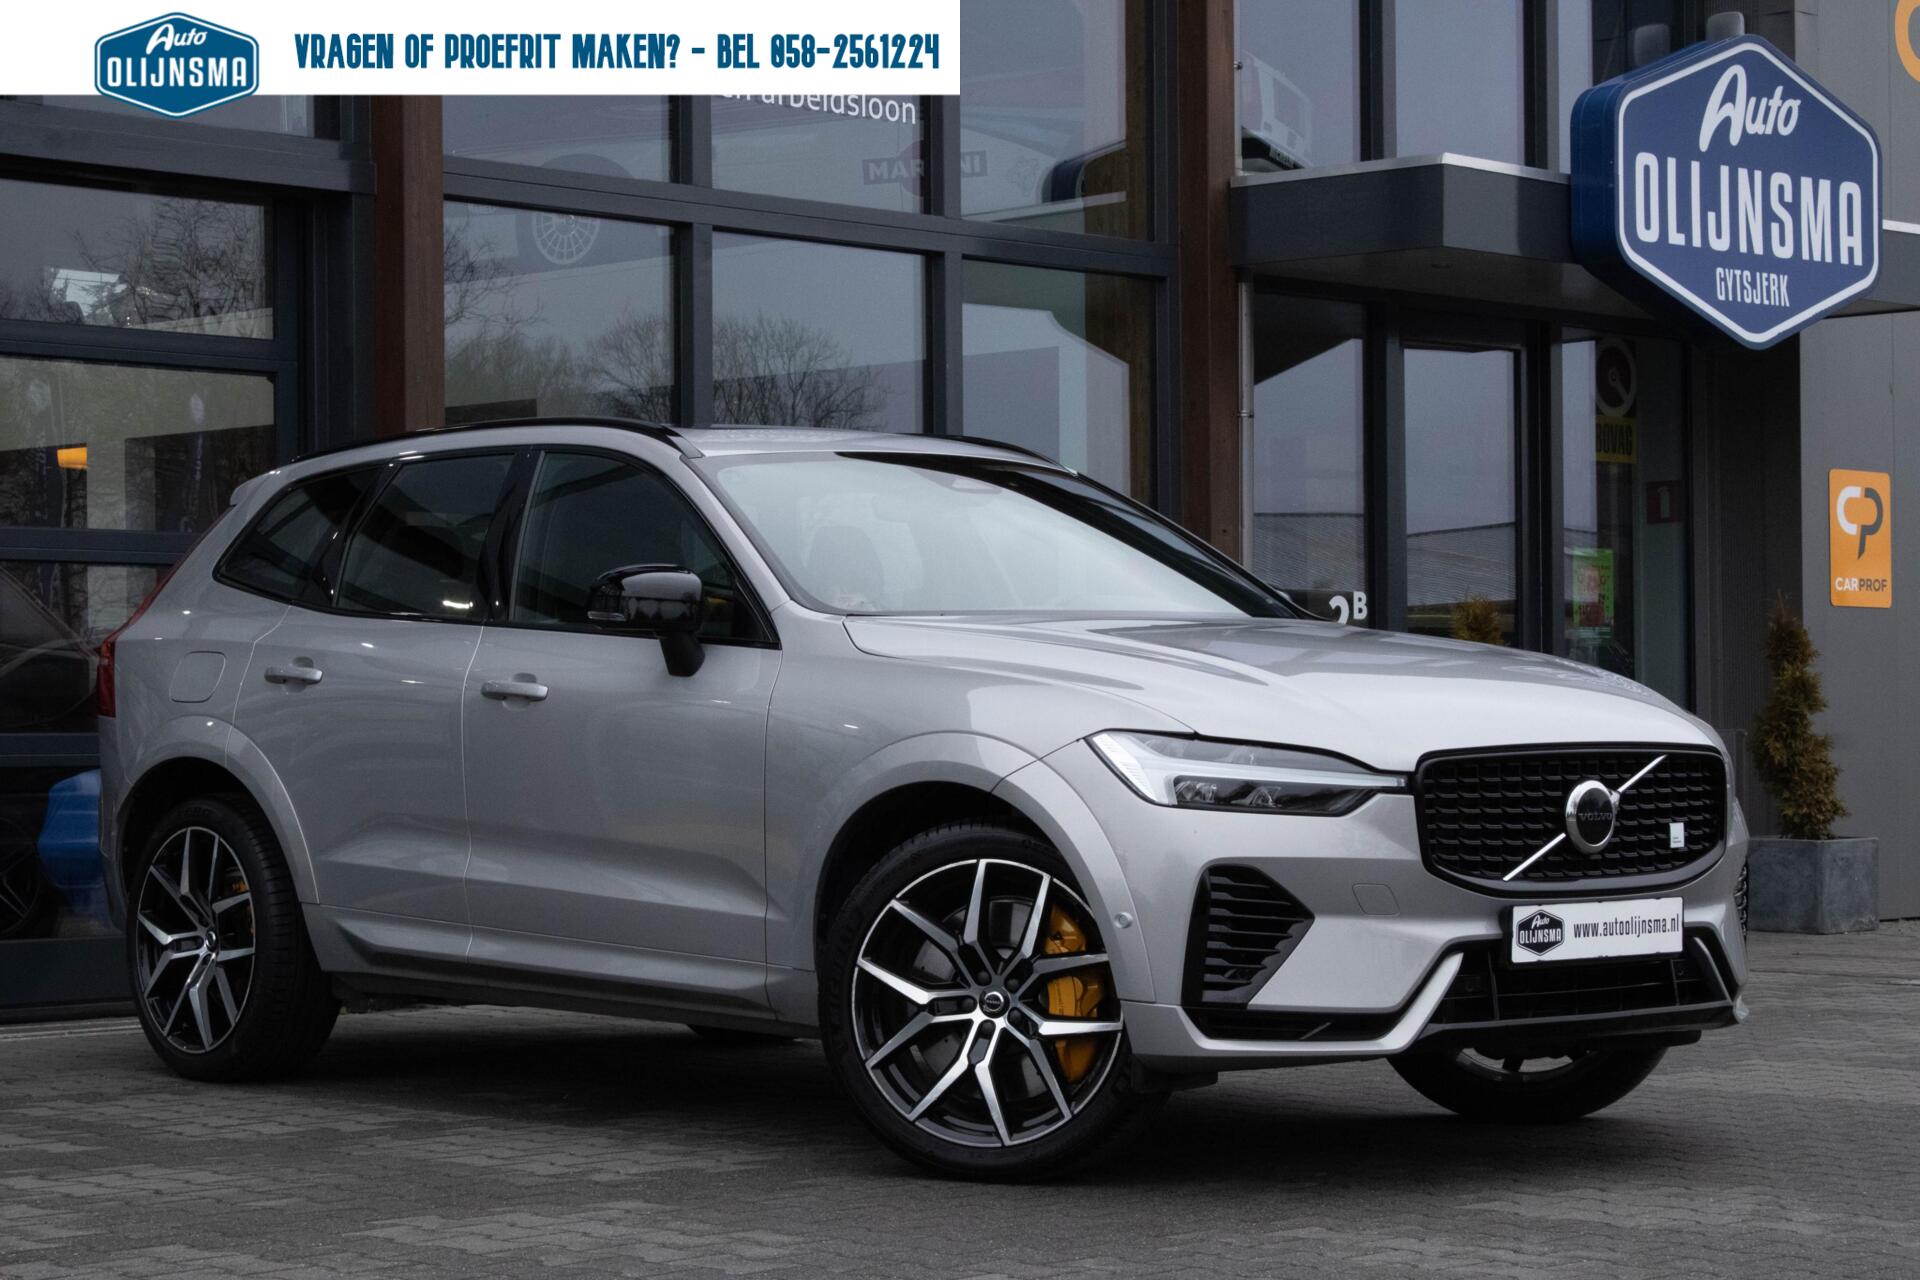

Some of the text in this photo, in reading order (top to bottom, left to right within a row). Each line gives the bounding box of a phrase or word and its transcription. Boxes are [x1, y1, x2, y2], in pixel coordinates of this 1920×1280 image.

[1699, 64, 1801, 152] Auto
[868, 154, 981, 181] MARNI
[1634, 152, 1863, 266] OLIJNSMA
[1715, 267, 1790, 307] GYTSJERK
[1835, 577, 1888, 592] CARPROF
[1531, 914, 1550, 929] Auto
[1573, 913, 1680, 939] www.autoolijnsma.nl
[1519, 928, 1562, 945] OLIJNSMA
